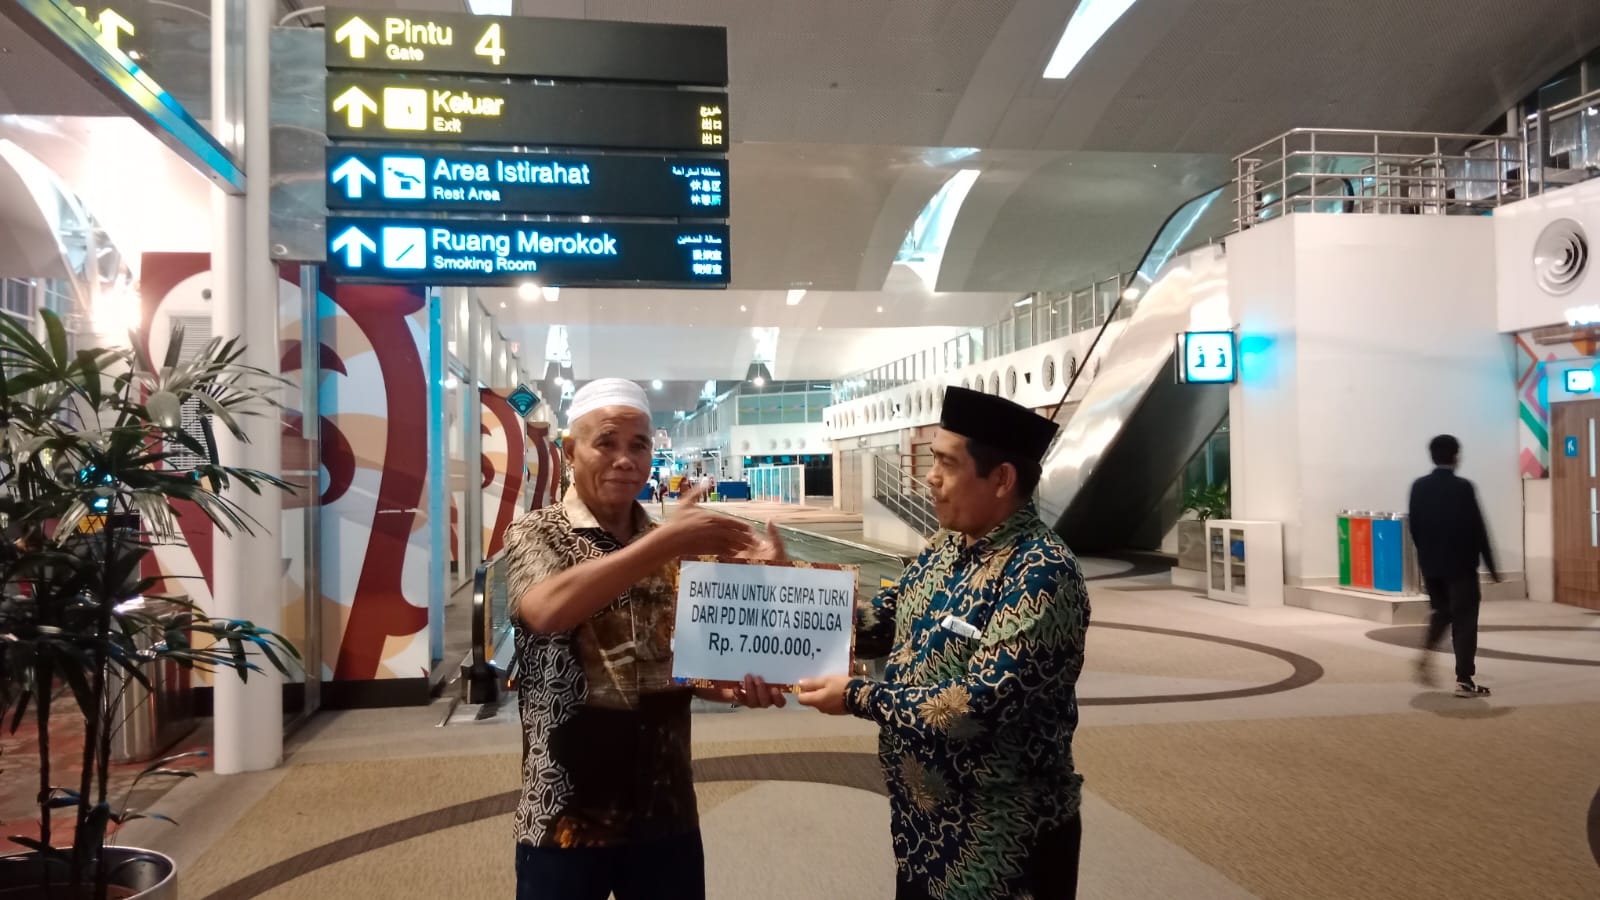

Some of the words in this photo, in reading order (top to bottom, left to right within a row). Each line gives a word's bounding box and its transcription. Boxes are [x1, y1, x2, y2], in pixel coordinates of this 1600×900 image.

[385, 17, 453, 46] Pintu
[474, 23, 505, 65] 4
[386, 44, 425, 62] Gate
[432, 90, 505, 117] Keluar
[432, 116, 462, 133] Exit
[433, 158, 490, 182] Area
[497, 160, 590, 184] Istirahat
[433, 185, 465, 201] Rest
[467, 186, 500, 202] Area
[431, 228, 509, 257] Ruang
[517, 231, 617, 256] Merokok
[433, 255, 494, 273] Smoking
[496, 257, 537, 272] Room
[689, 580, 739, 601] BANTUAN
[742, 583, 777, 603] UNTUK
[779, 585, 815, 605] GEMPA
[818, 588, 849, 607] TURKI
[691, 604, 718, 624] DARI
[720, 606, 736, 625] PD
[738, 607, 759, 627] DMI
[761, 608, 791, 629] KOTA
[793, 610, 842, 632] SIBOLGA
[709, 632, 734, 656] Rp.
[740, 634, 821, 661] 7.000.000,-
